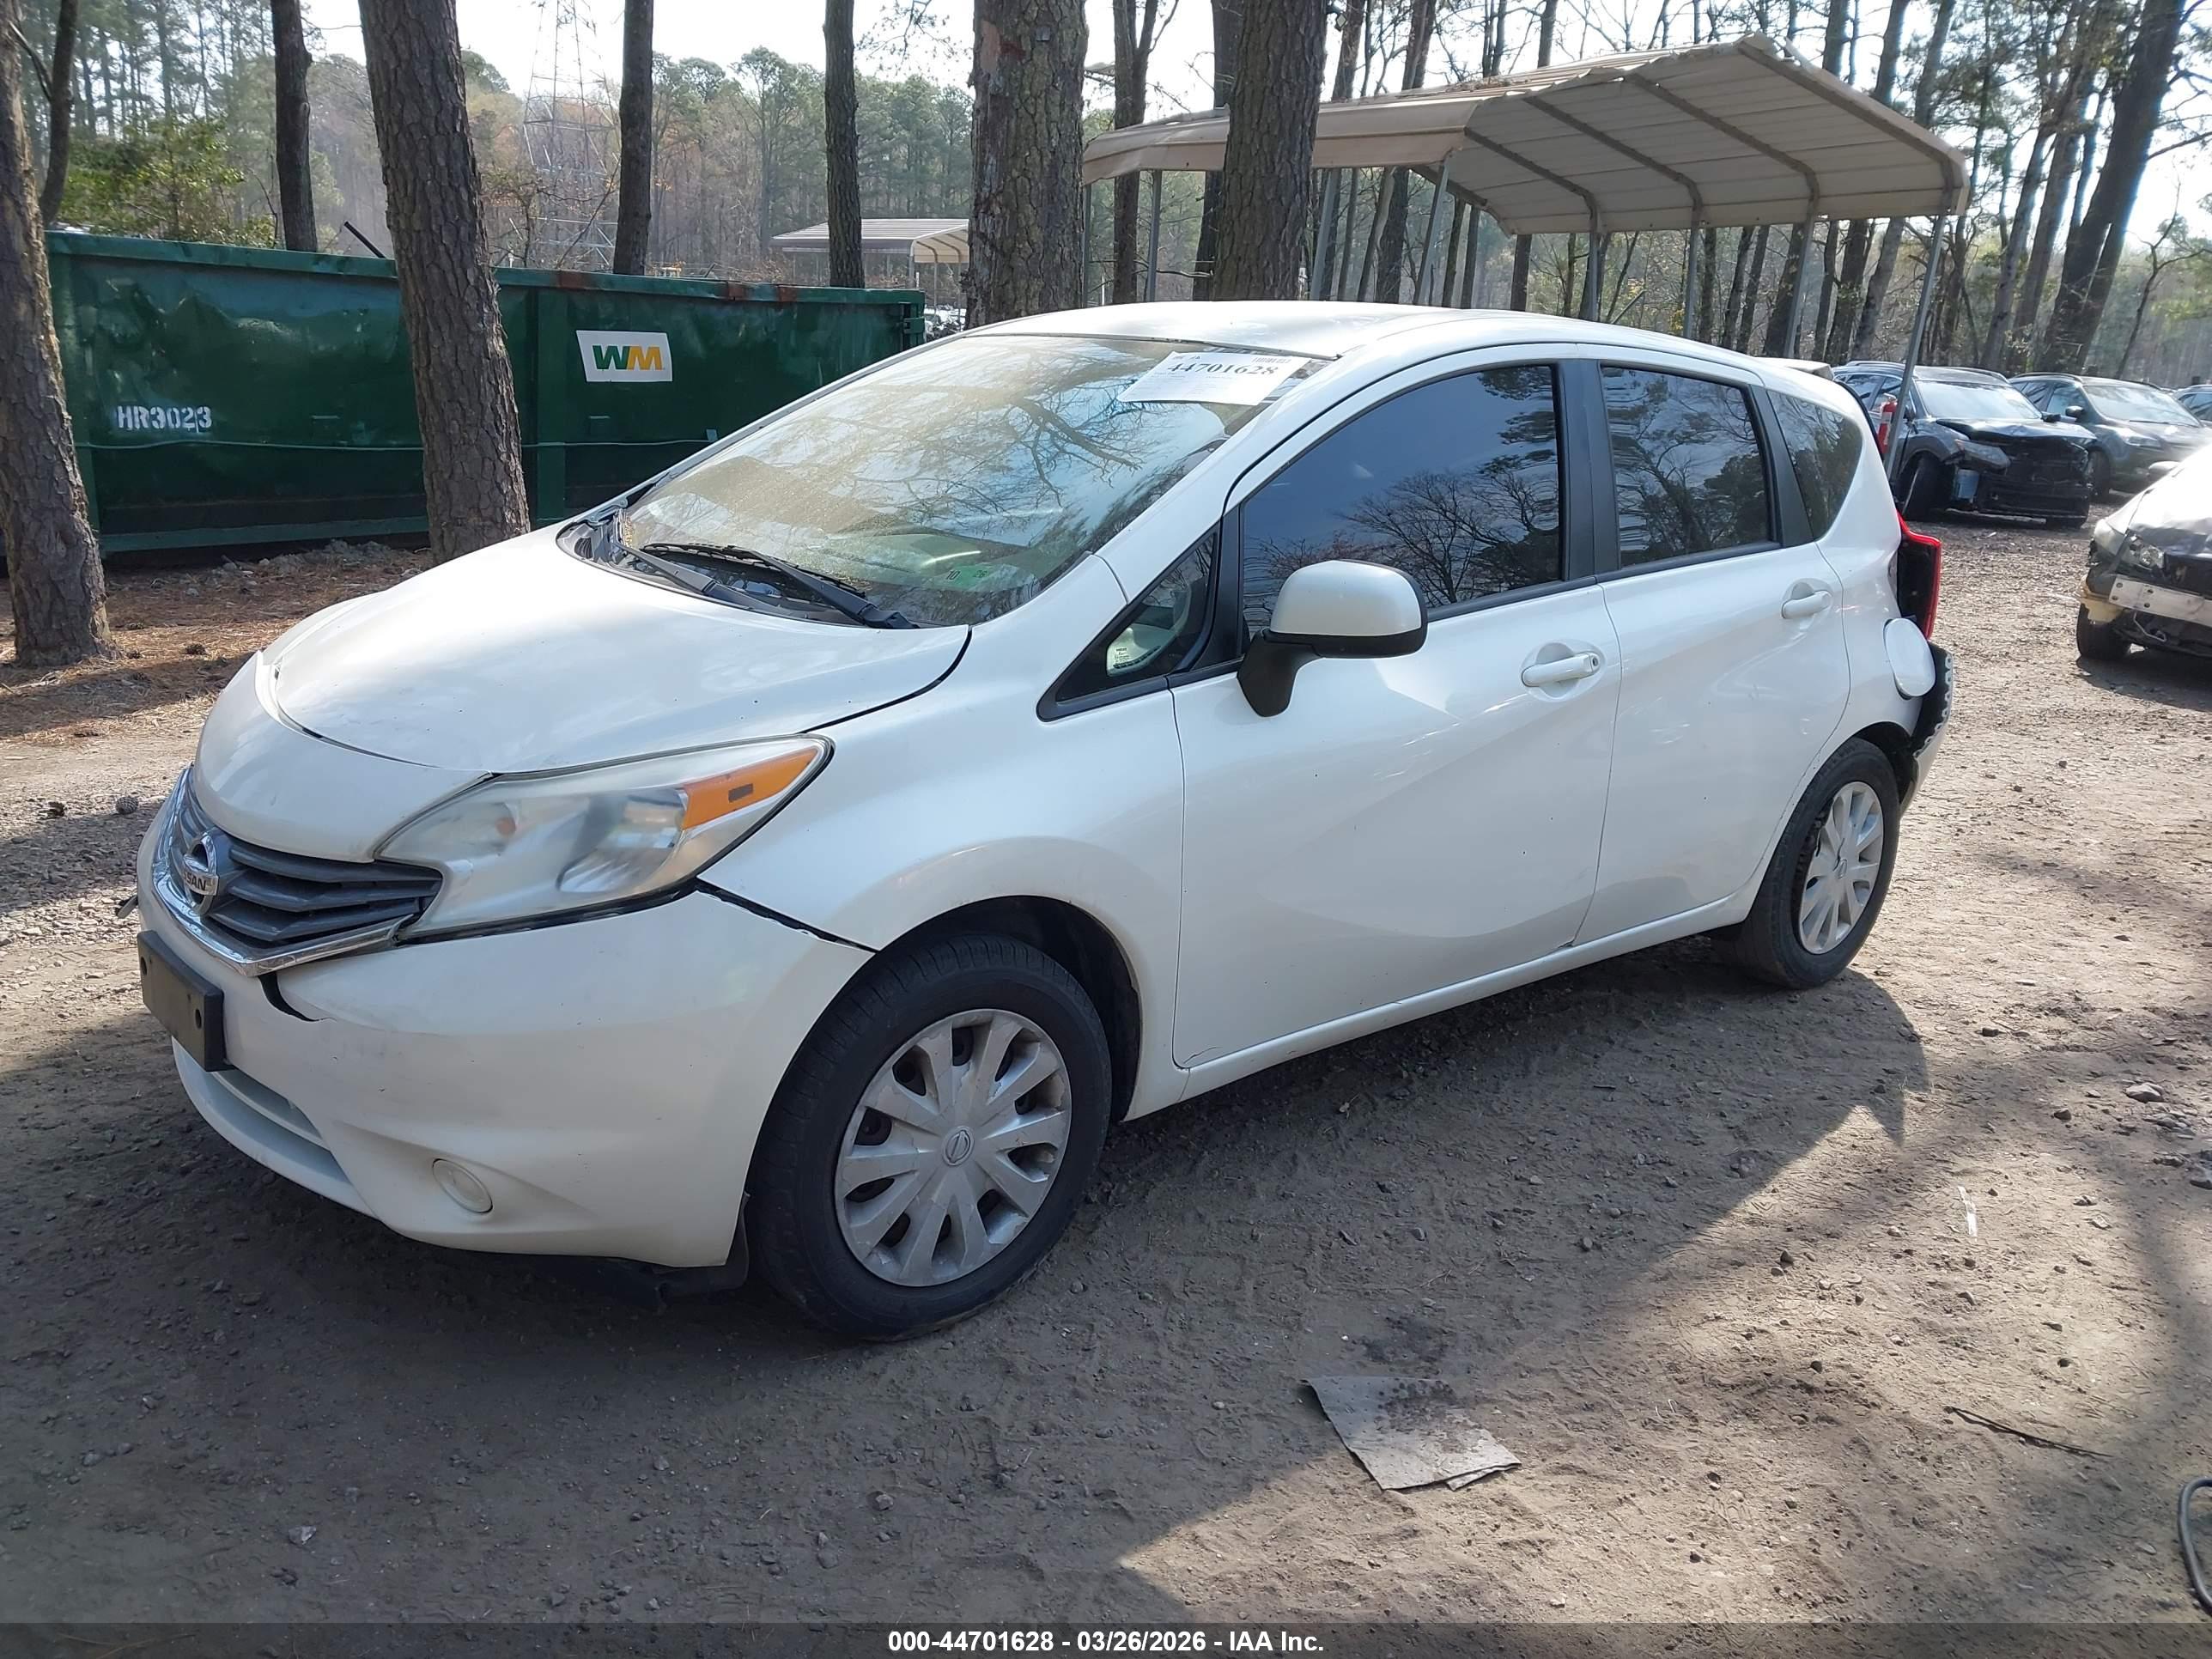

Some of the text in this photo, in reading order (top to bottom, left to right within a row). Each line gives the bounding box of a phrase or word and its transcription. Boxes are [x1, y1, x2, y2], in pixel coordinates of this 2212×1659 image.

[592, 345, 663, 370] WM
[1167, 362, 1279, 375] 44701628
[117, 405, 212, 430] HR3023
[945, 570, 962, 580] 10
